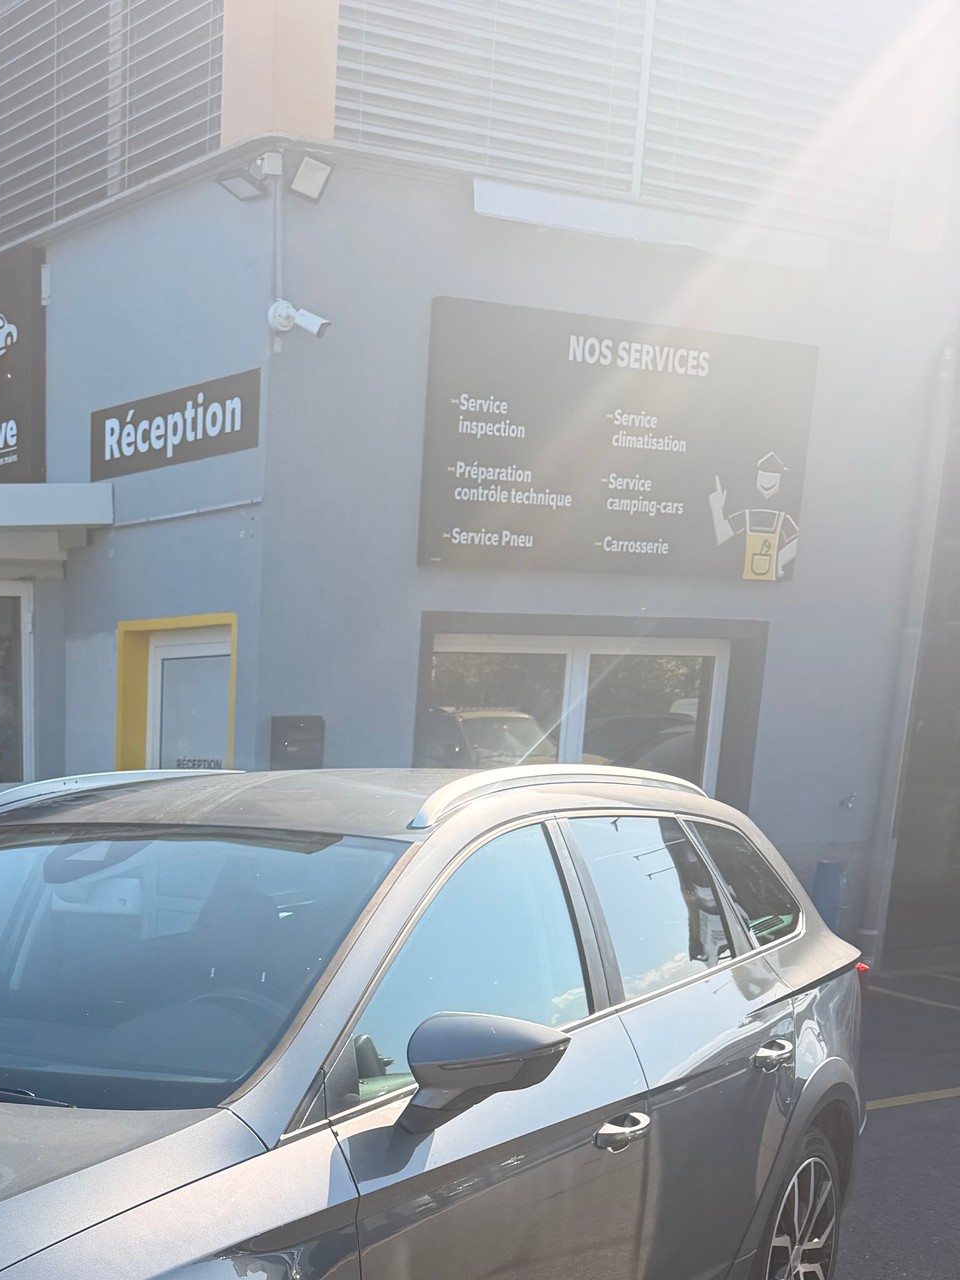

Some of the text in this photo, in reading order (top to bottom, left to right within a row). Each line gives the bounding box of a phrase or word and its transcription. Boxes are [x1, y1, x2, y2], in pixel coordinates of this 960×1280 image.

[568, 334, 710, 377] NOS SERVICES
[104, 391, 242, 461] Réception
[458, 415, 526, 439] inspection
[611, 430, 687, 453] climatisation
[454, 484, 573, 510] contrôle technique
[606, 495, 684, 517] camping-cars
[501, 530, 534, 547] Pneu
